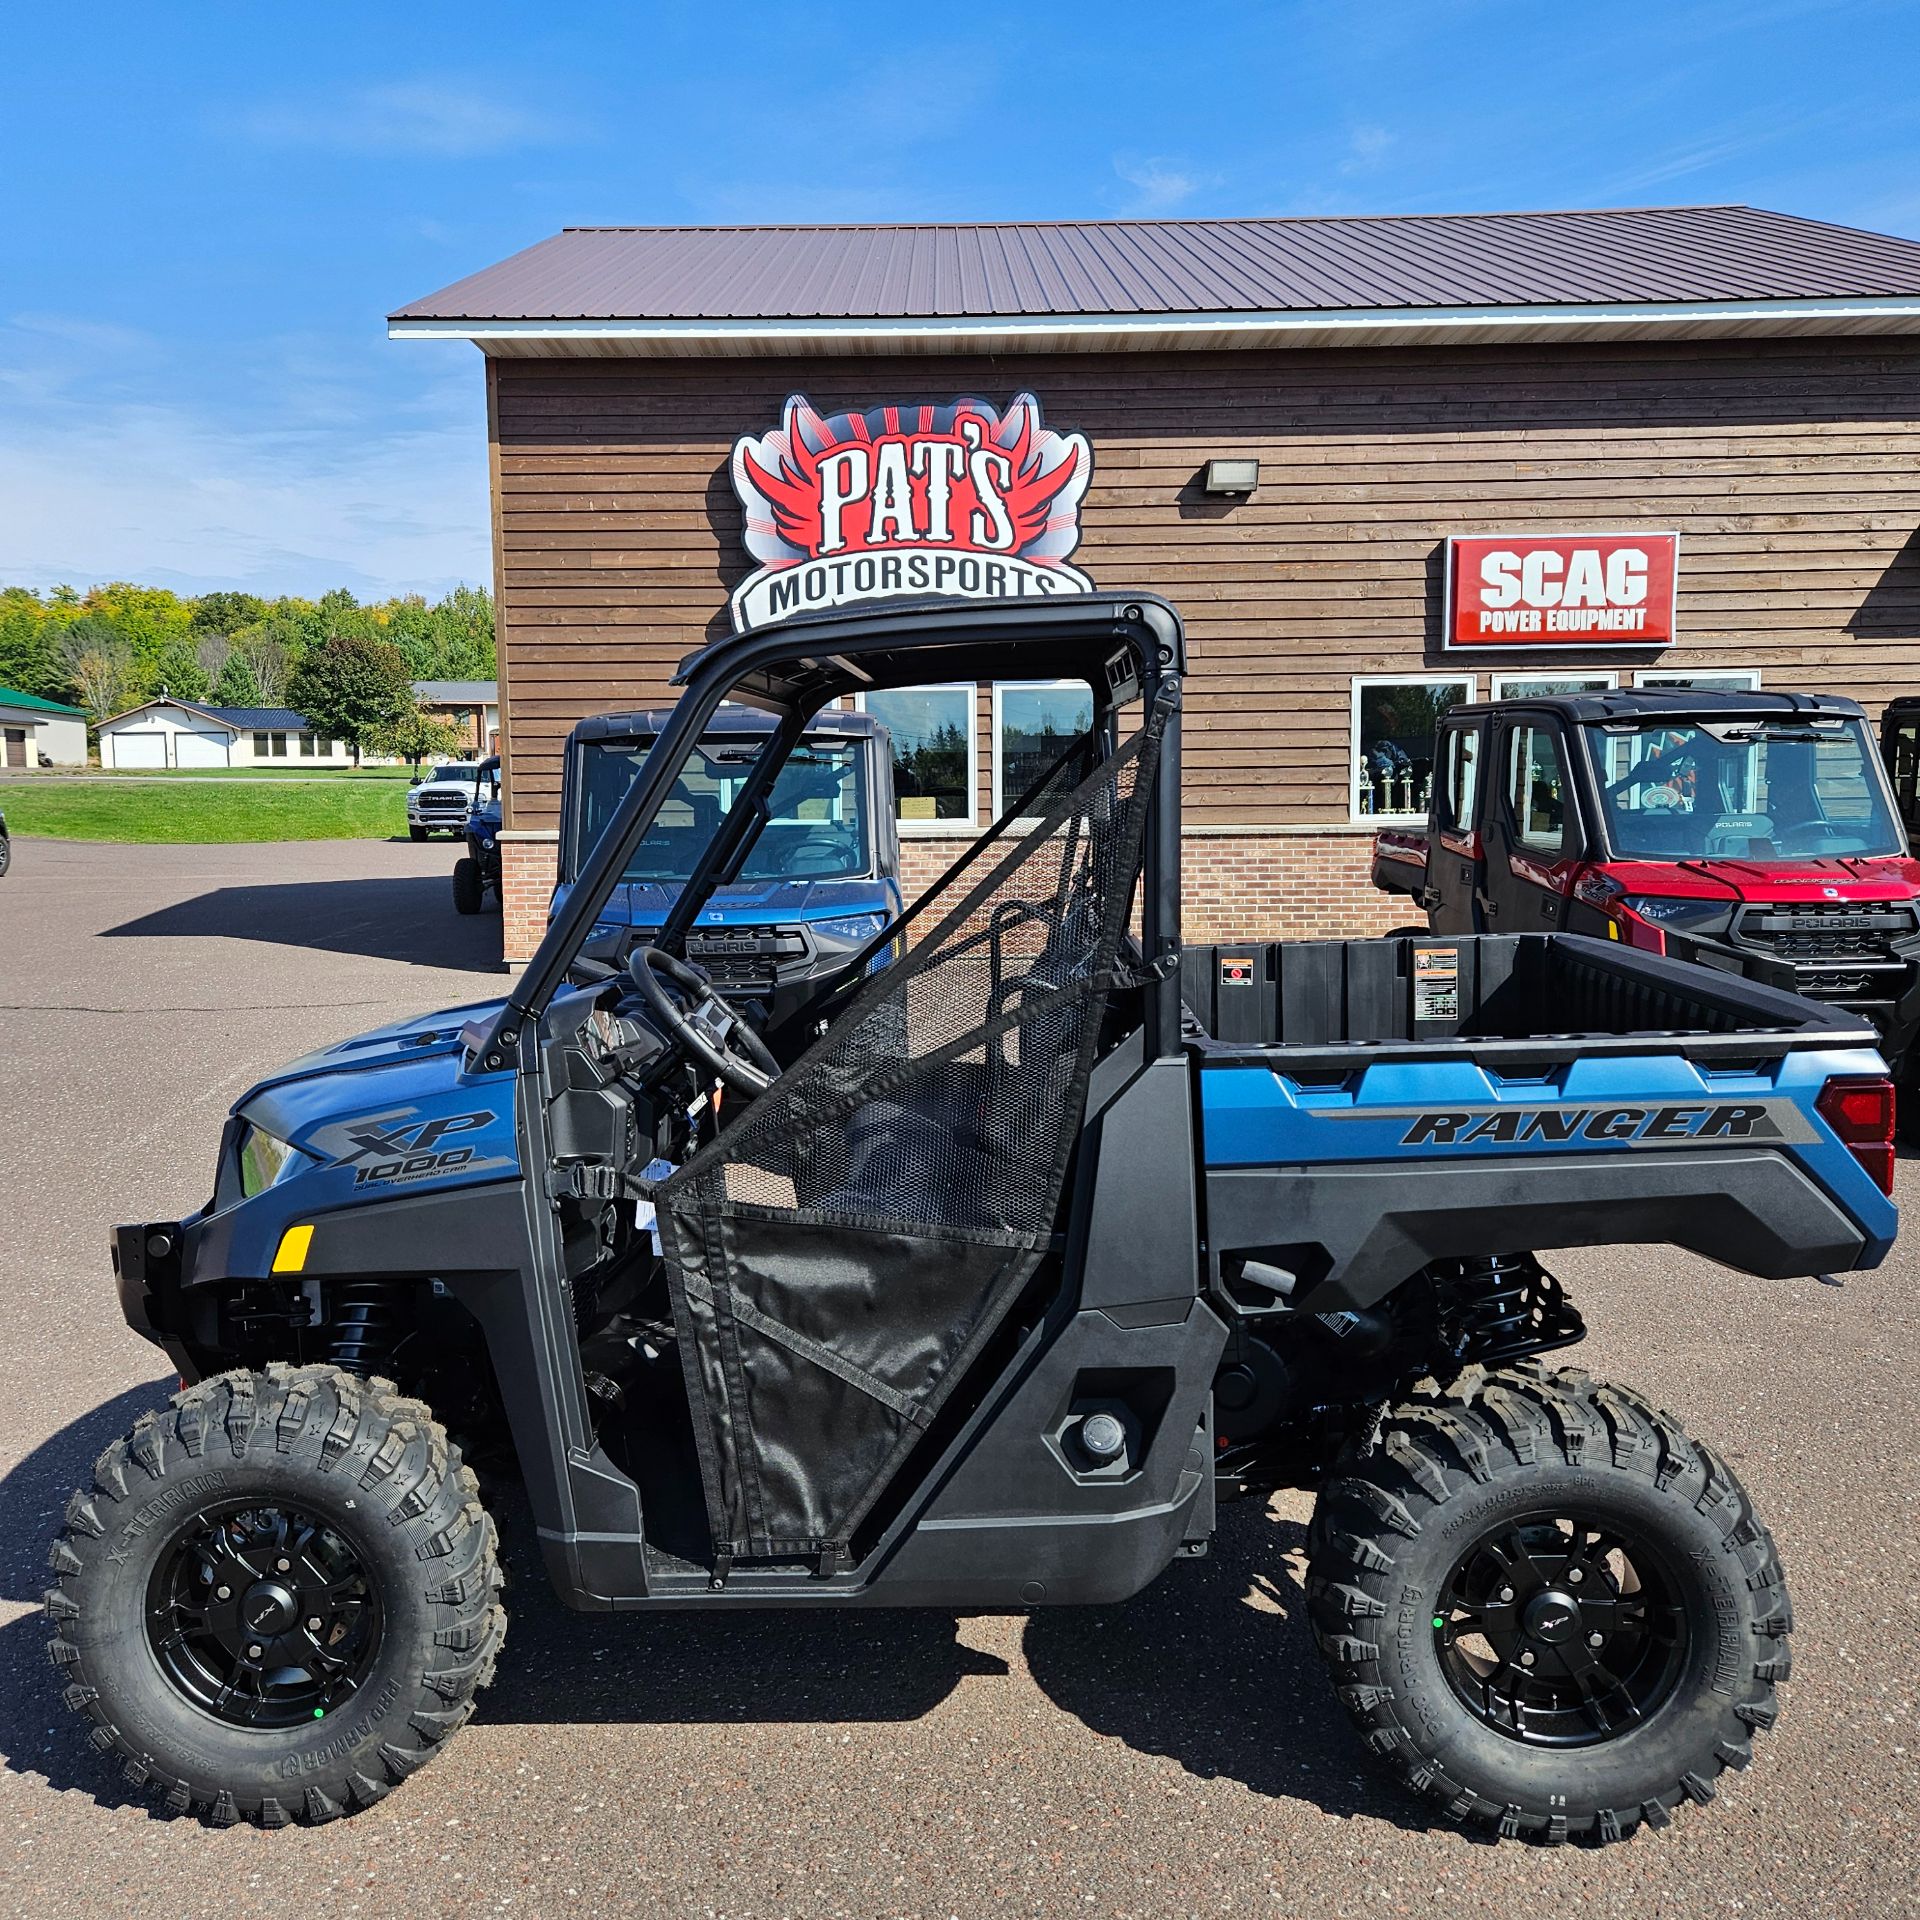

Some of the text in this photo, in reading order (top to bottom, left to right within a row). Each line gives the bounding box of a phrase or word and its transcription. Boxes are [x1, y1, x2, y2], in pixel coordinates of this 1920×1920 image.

[816, 422, 1014, 554] PAT'S
[769, 555, 1056, 616] MOTORSPORTS
[1480, 549, 1648, 608] SCAG
[1480, 608, 1647, 632] POWER EQUIPMENT
[1791, 917, 1871, 929] POLARIS
[328, 1111, 497, 1168] XP
[1400, 1104, 1768, 1145] RANGER
[354, 1148, 474, 1184] 1000
[105, 1470, 228, 1567] X-TERRAIN
[1689, 1545, 1741, 1696] X-TERRAIN
